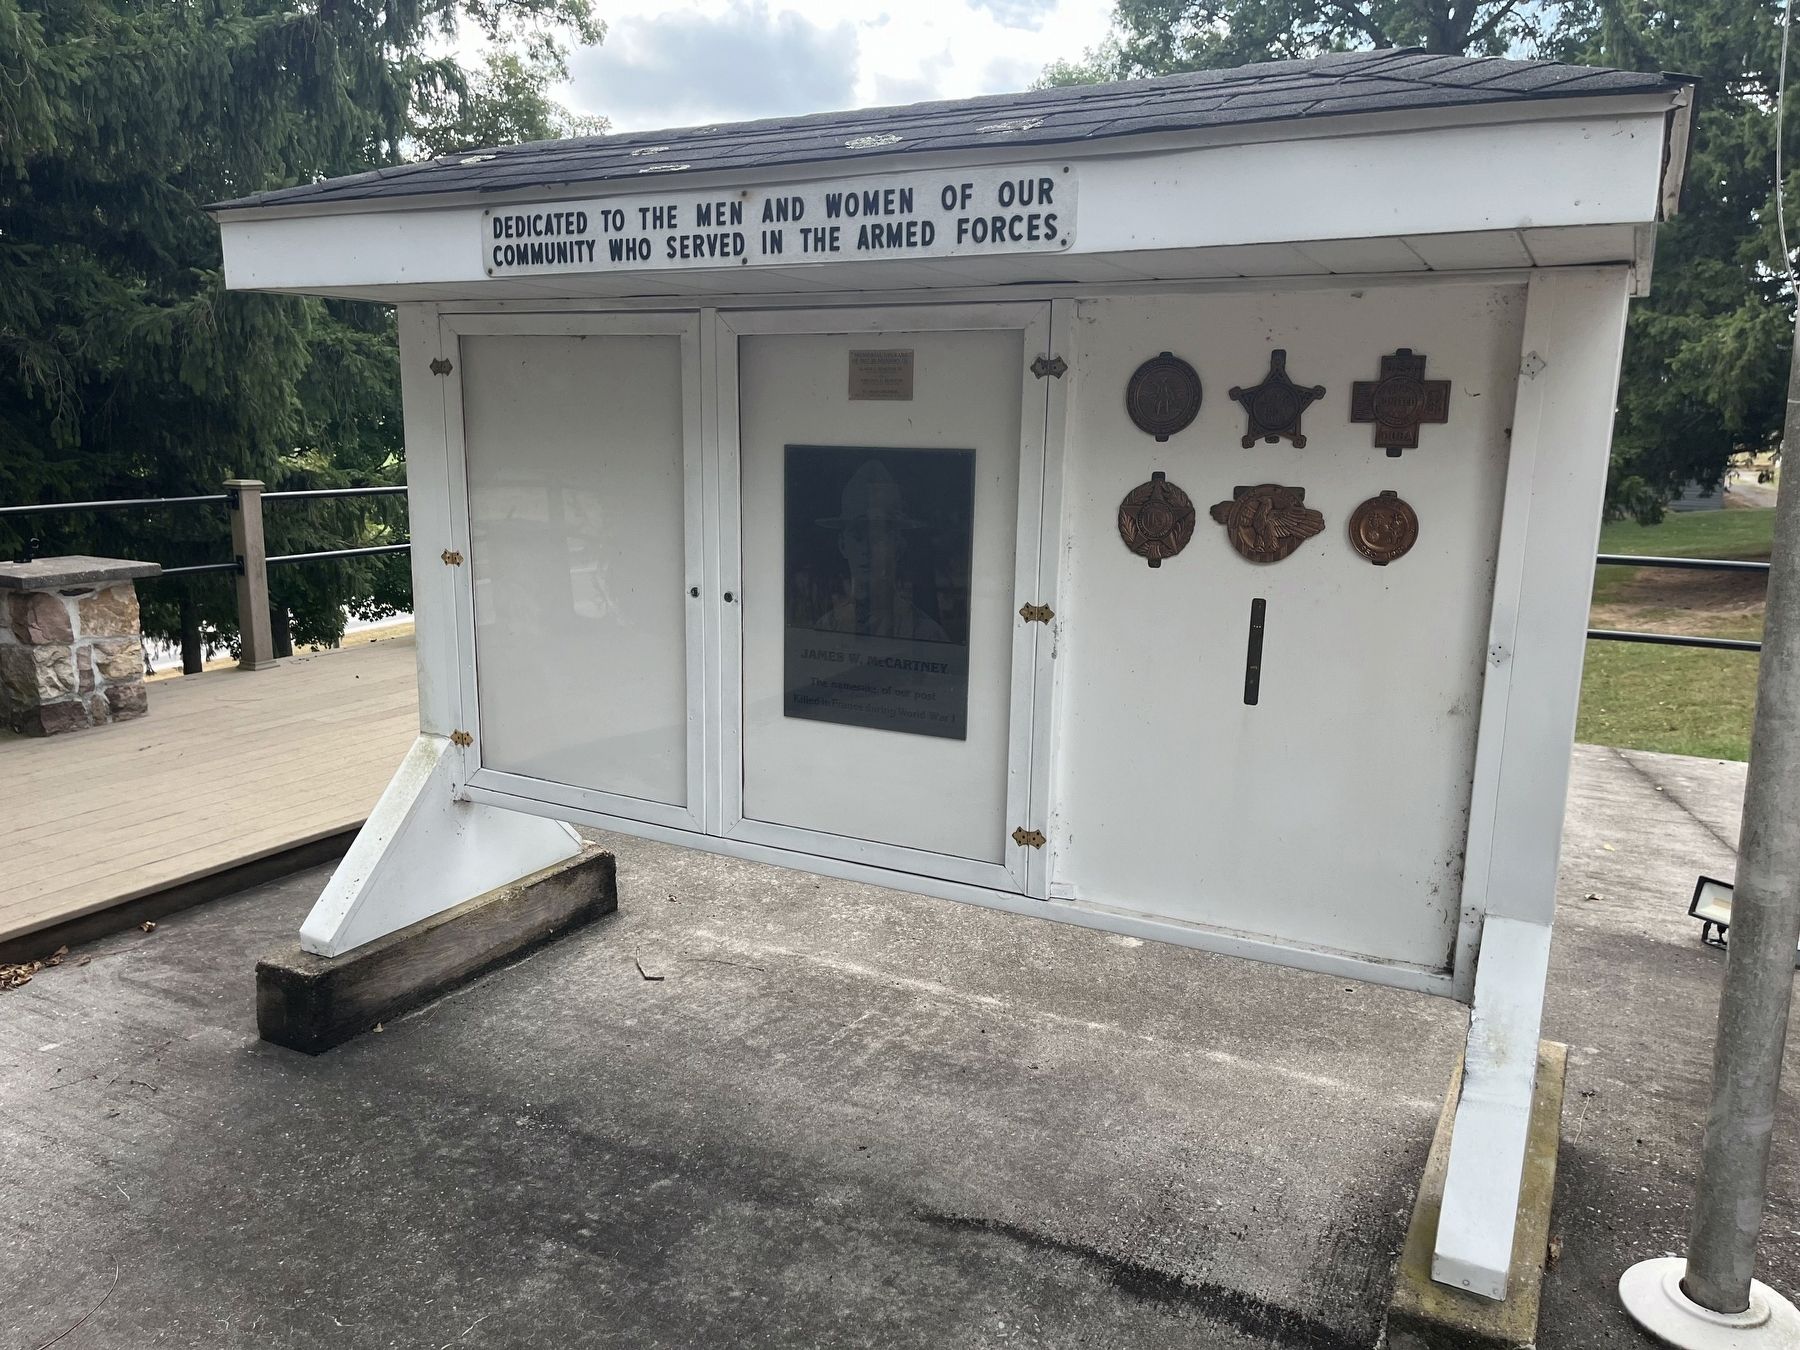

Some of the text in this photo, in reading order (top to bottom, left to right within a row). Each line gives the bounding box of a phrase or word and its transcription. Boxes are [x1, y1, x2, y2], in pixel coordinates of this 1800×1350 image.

[493, 177, 1054, 239] DEDICATED TO THE MEN AND WOMEN OF OUR
[493, 213, 1058, 266] COMMUNITY WHO SERVED IN THE ARMED FORCES
[801, 649, 845, 663] JAMES
[866, 656, 948, 674] McCARTNEY
[881, 685, 892, 695] of
[914, 690, 936, 702] post
